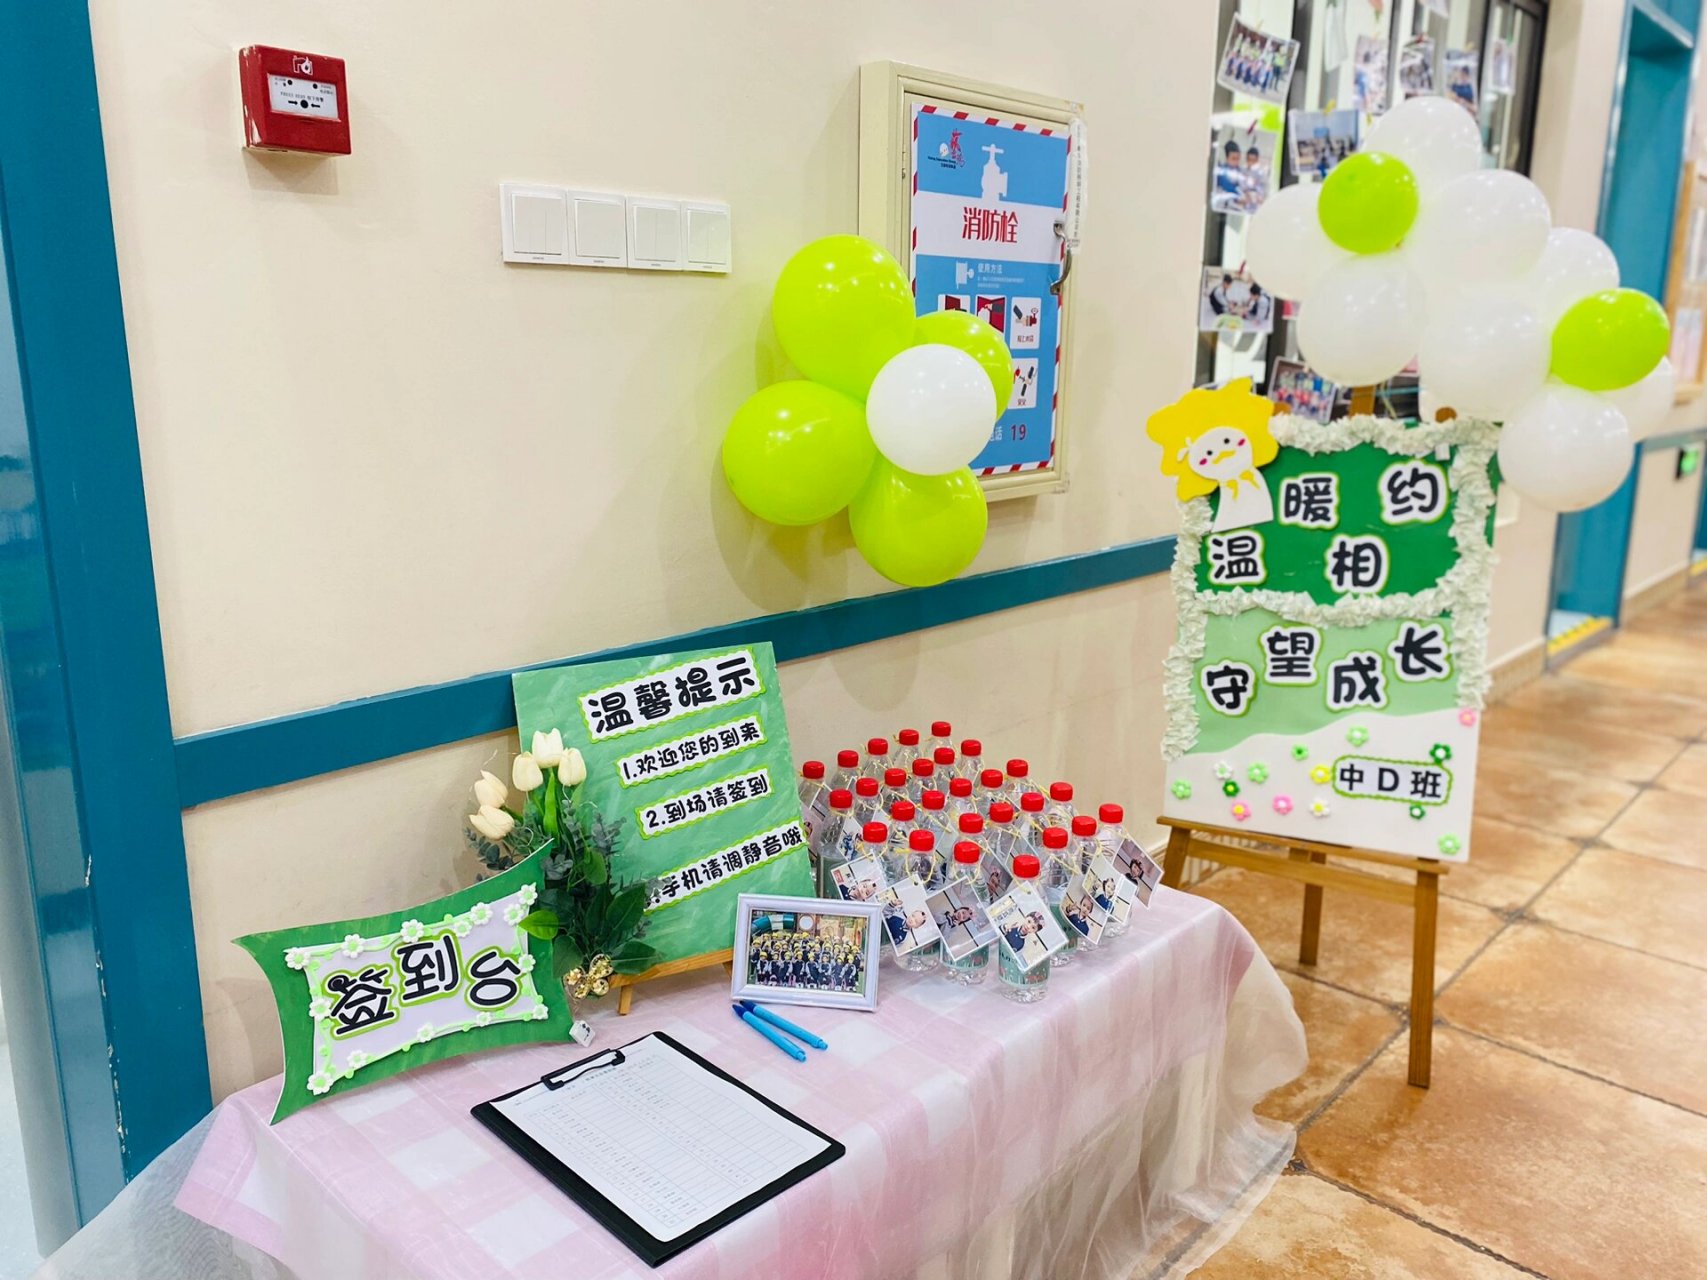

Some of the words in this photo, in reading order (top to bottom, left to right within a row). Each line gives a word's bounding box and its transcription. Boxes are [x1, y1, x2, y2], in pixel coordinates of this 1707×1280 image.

[962, 206, 1018, 243] 消防栓
[587, 656, 757, 734] 温馨提示
[1206, 626, 1443, 709] 守望成长
[623, 722, 761, 780] 1.欢迎您的到来
[646, 773, 770, 829] 2.到场请签到
[647, 826, 803, 906] .手机请调静音哦
[327, 935, 521, 1035] 签到台
